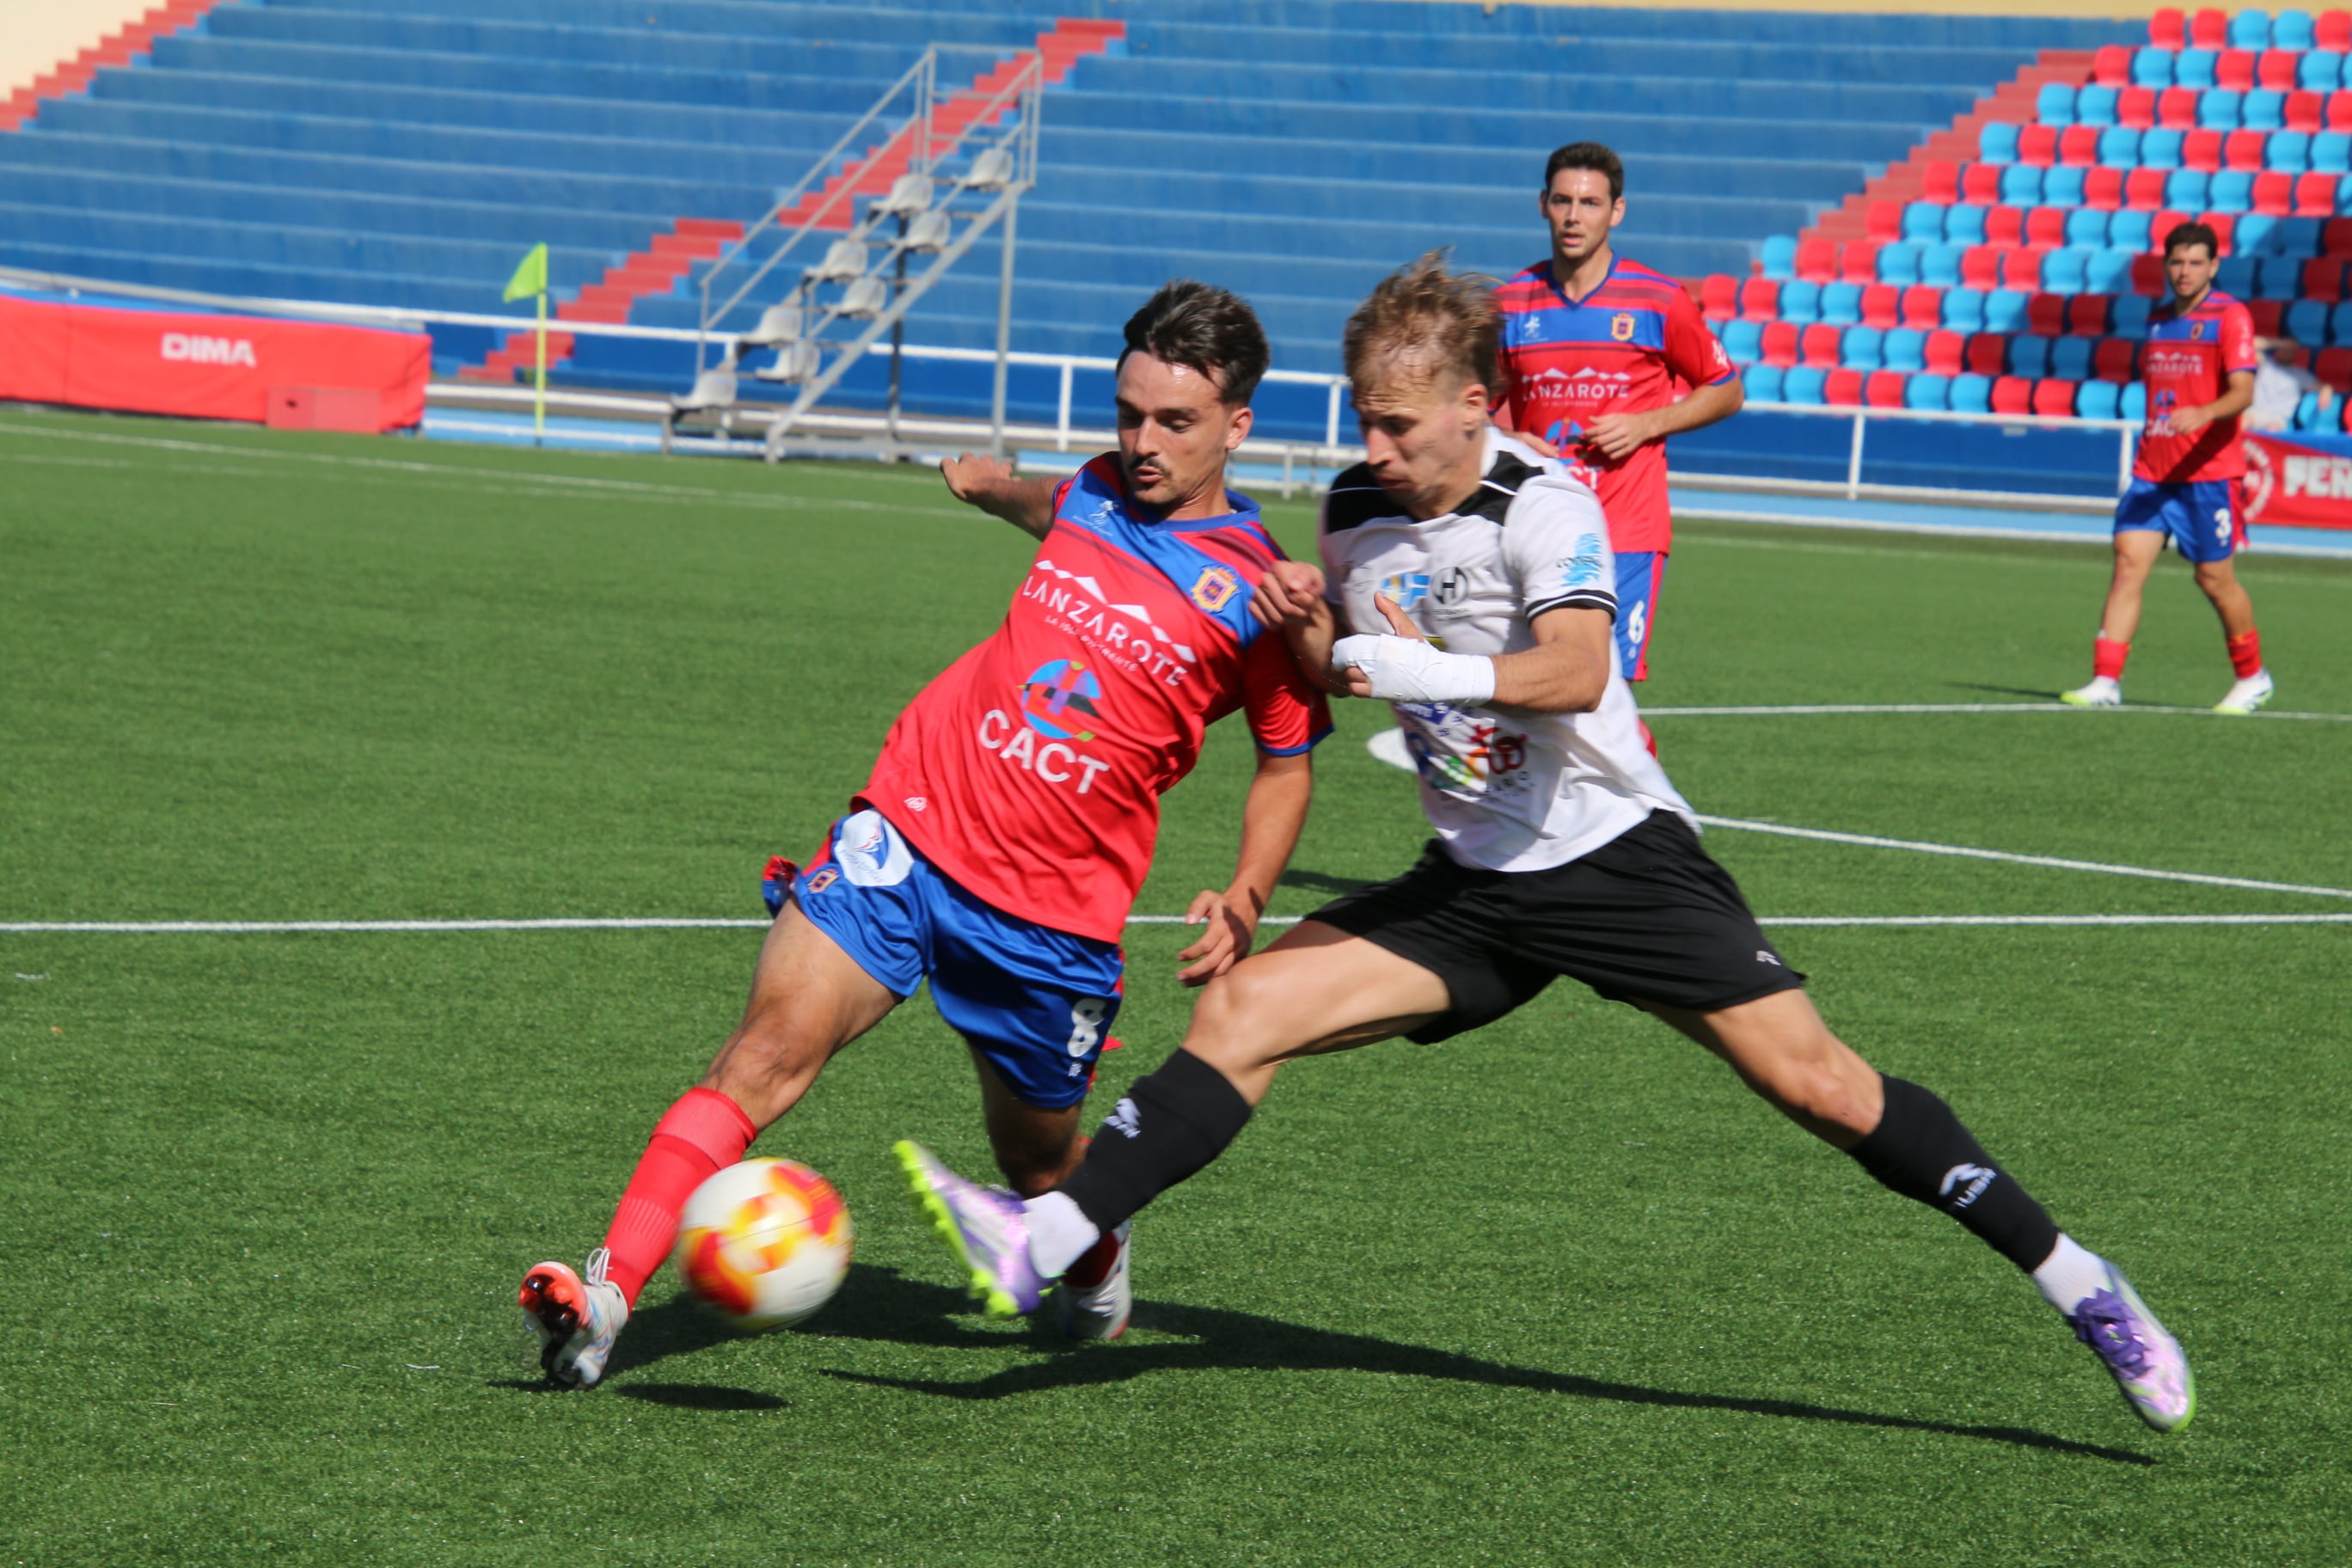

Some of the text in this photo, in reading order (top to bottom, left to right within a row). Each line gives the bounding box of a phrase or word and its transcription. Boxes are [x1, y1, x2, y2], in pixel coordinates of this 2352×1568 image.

[161, 332, 257, 368] DIMA
[2147, 361, 2203, 376] ANZAROTE
[1522, 381, 1630, 401] ANZAROTE
[2214, 508, 2232, 538] 3
[1021, 574, 1188, 687] LANZAROTE
[1628, 599, 1645, 645] 6
[978, 709, 1109, 794] CACT
[1066, 997, 1106, 1057] 8
